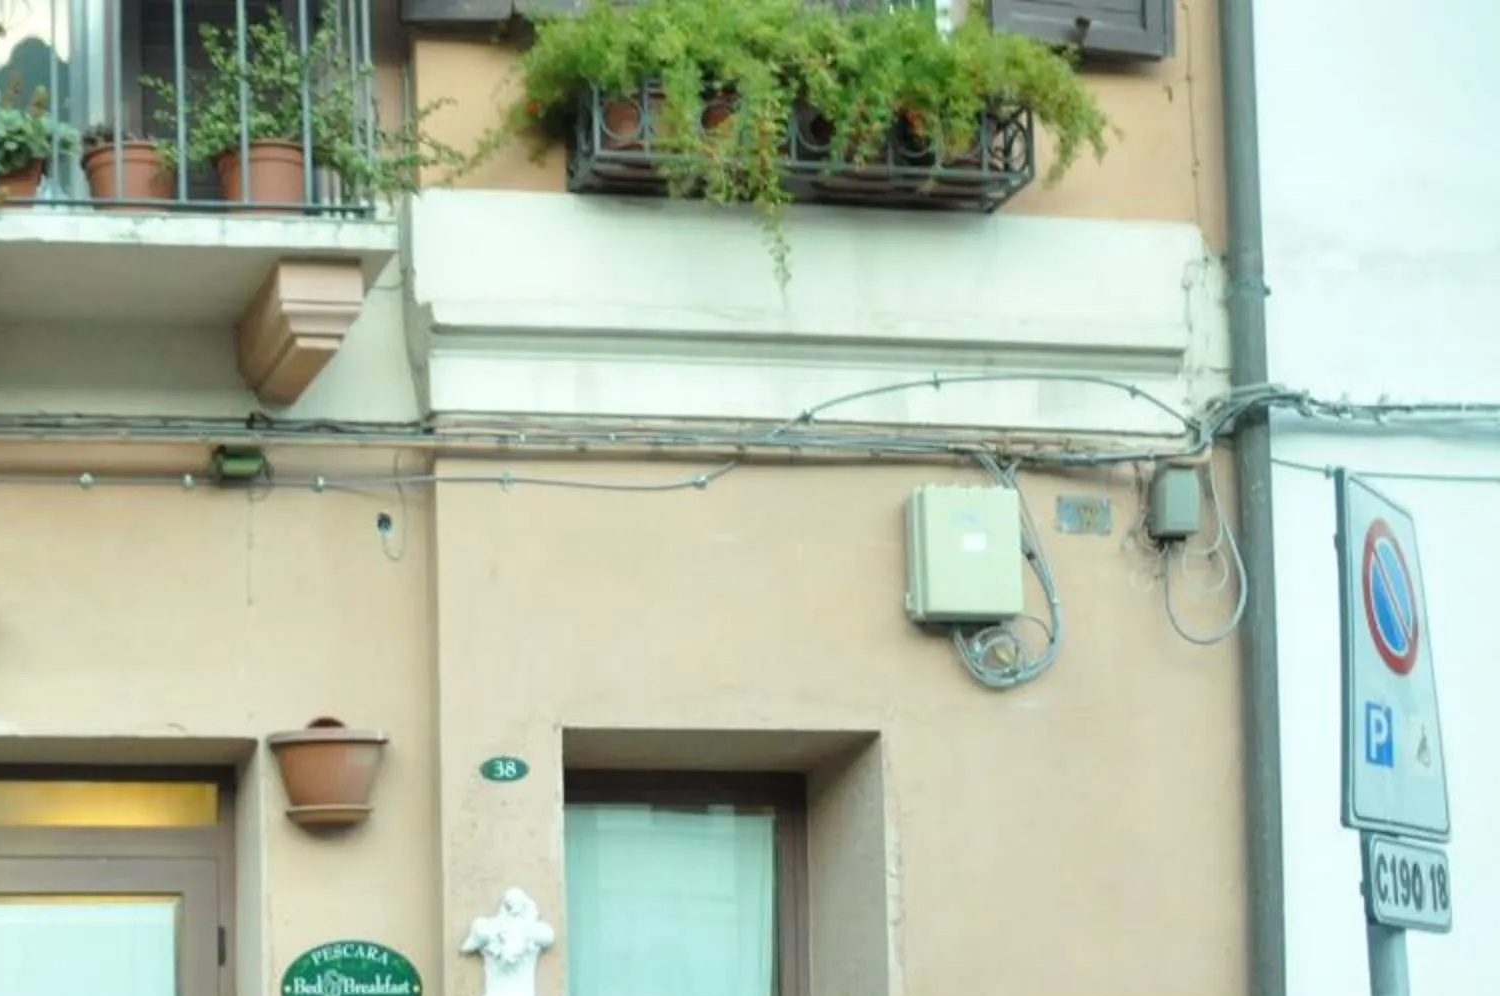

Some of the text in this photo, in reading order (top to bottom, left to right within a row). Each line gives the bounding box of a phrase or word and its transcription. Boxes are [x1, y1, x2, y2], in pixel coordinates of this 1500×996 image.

[1369, 708, 1389, 761] P
[492, 759, 517, 778] 38
[1430, 863, 1449, 912] 18
[311, 943, 388, 966] PESCARA
[293, 973, 323, 995] Bed
[341, 972, 409, 994] Breakfast
